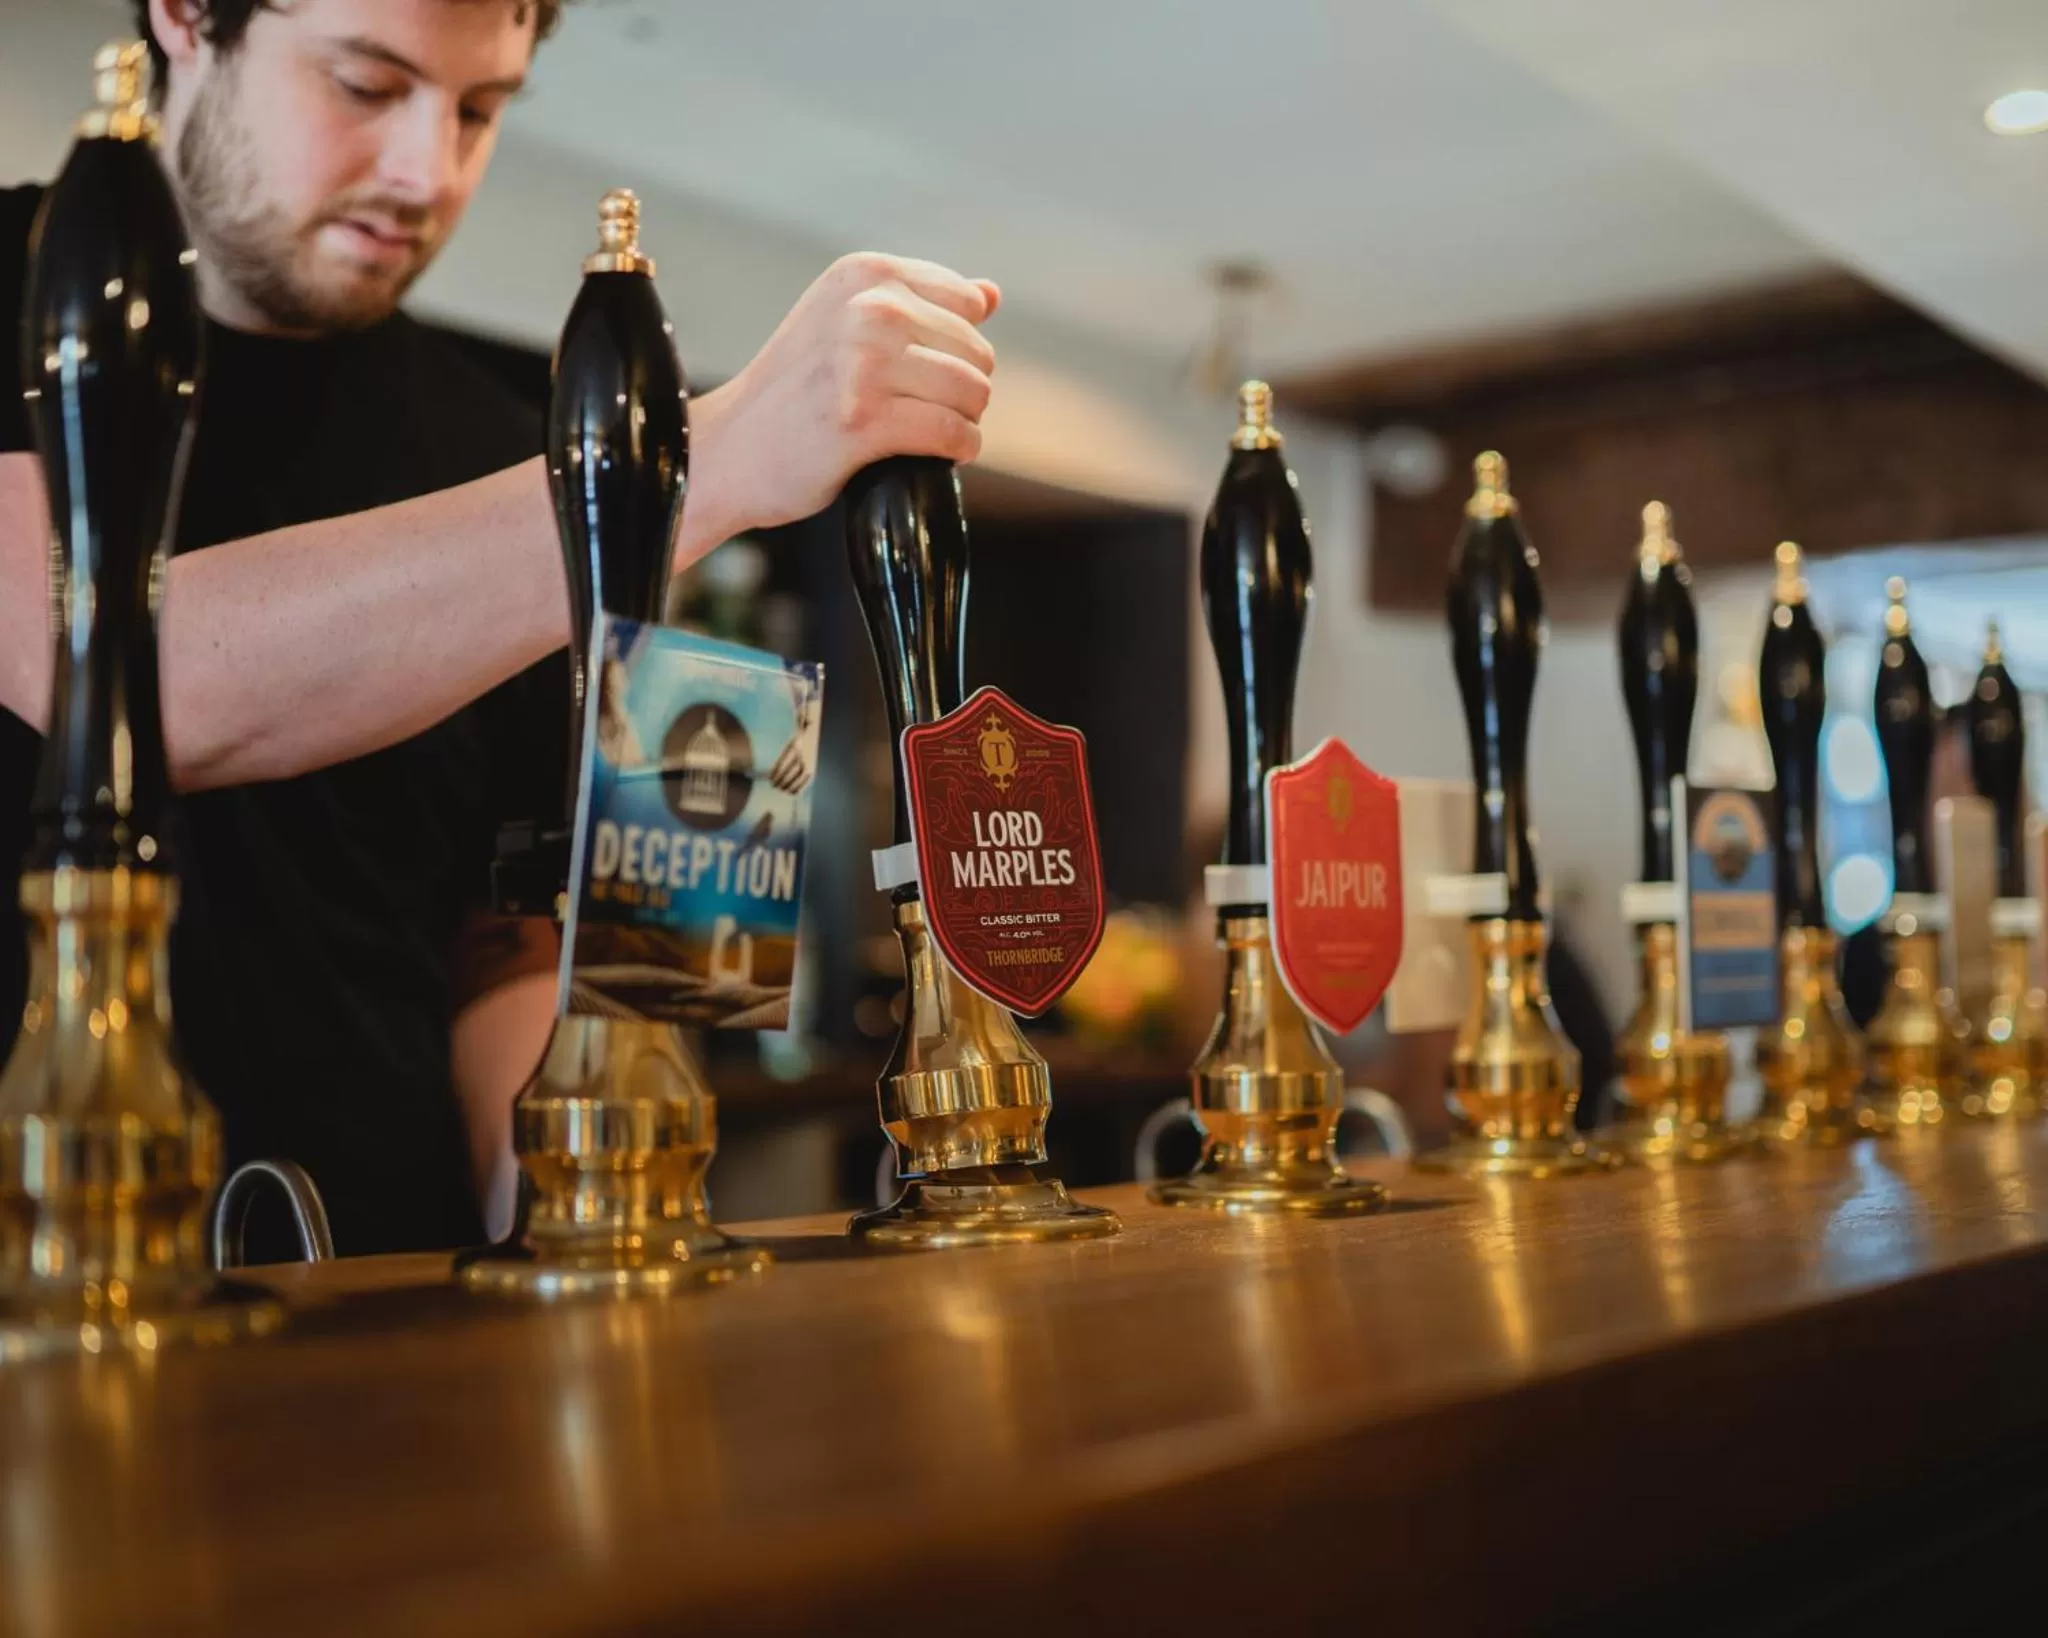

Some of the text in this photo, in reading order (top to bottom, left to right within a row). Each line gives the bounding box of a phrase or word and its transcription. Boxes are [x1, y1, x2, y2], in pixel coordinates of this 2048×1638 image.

[972, 810, 1044, 848] LORD
[591, 820, 797, 902] DECEPTION
[950, 848, 1076, 888] MARPLES
[1295, 860, 1387, 909] JAIPUR
[980, 912, 1061, 926] CLASSIC BITTER
[986, 946, 1065, 967] THORNBRIDGE
